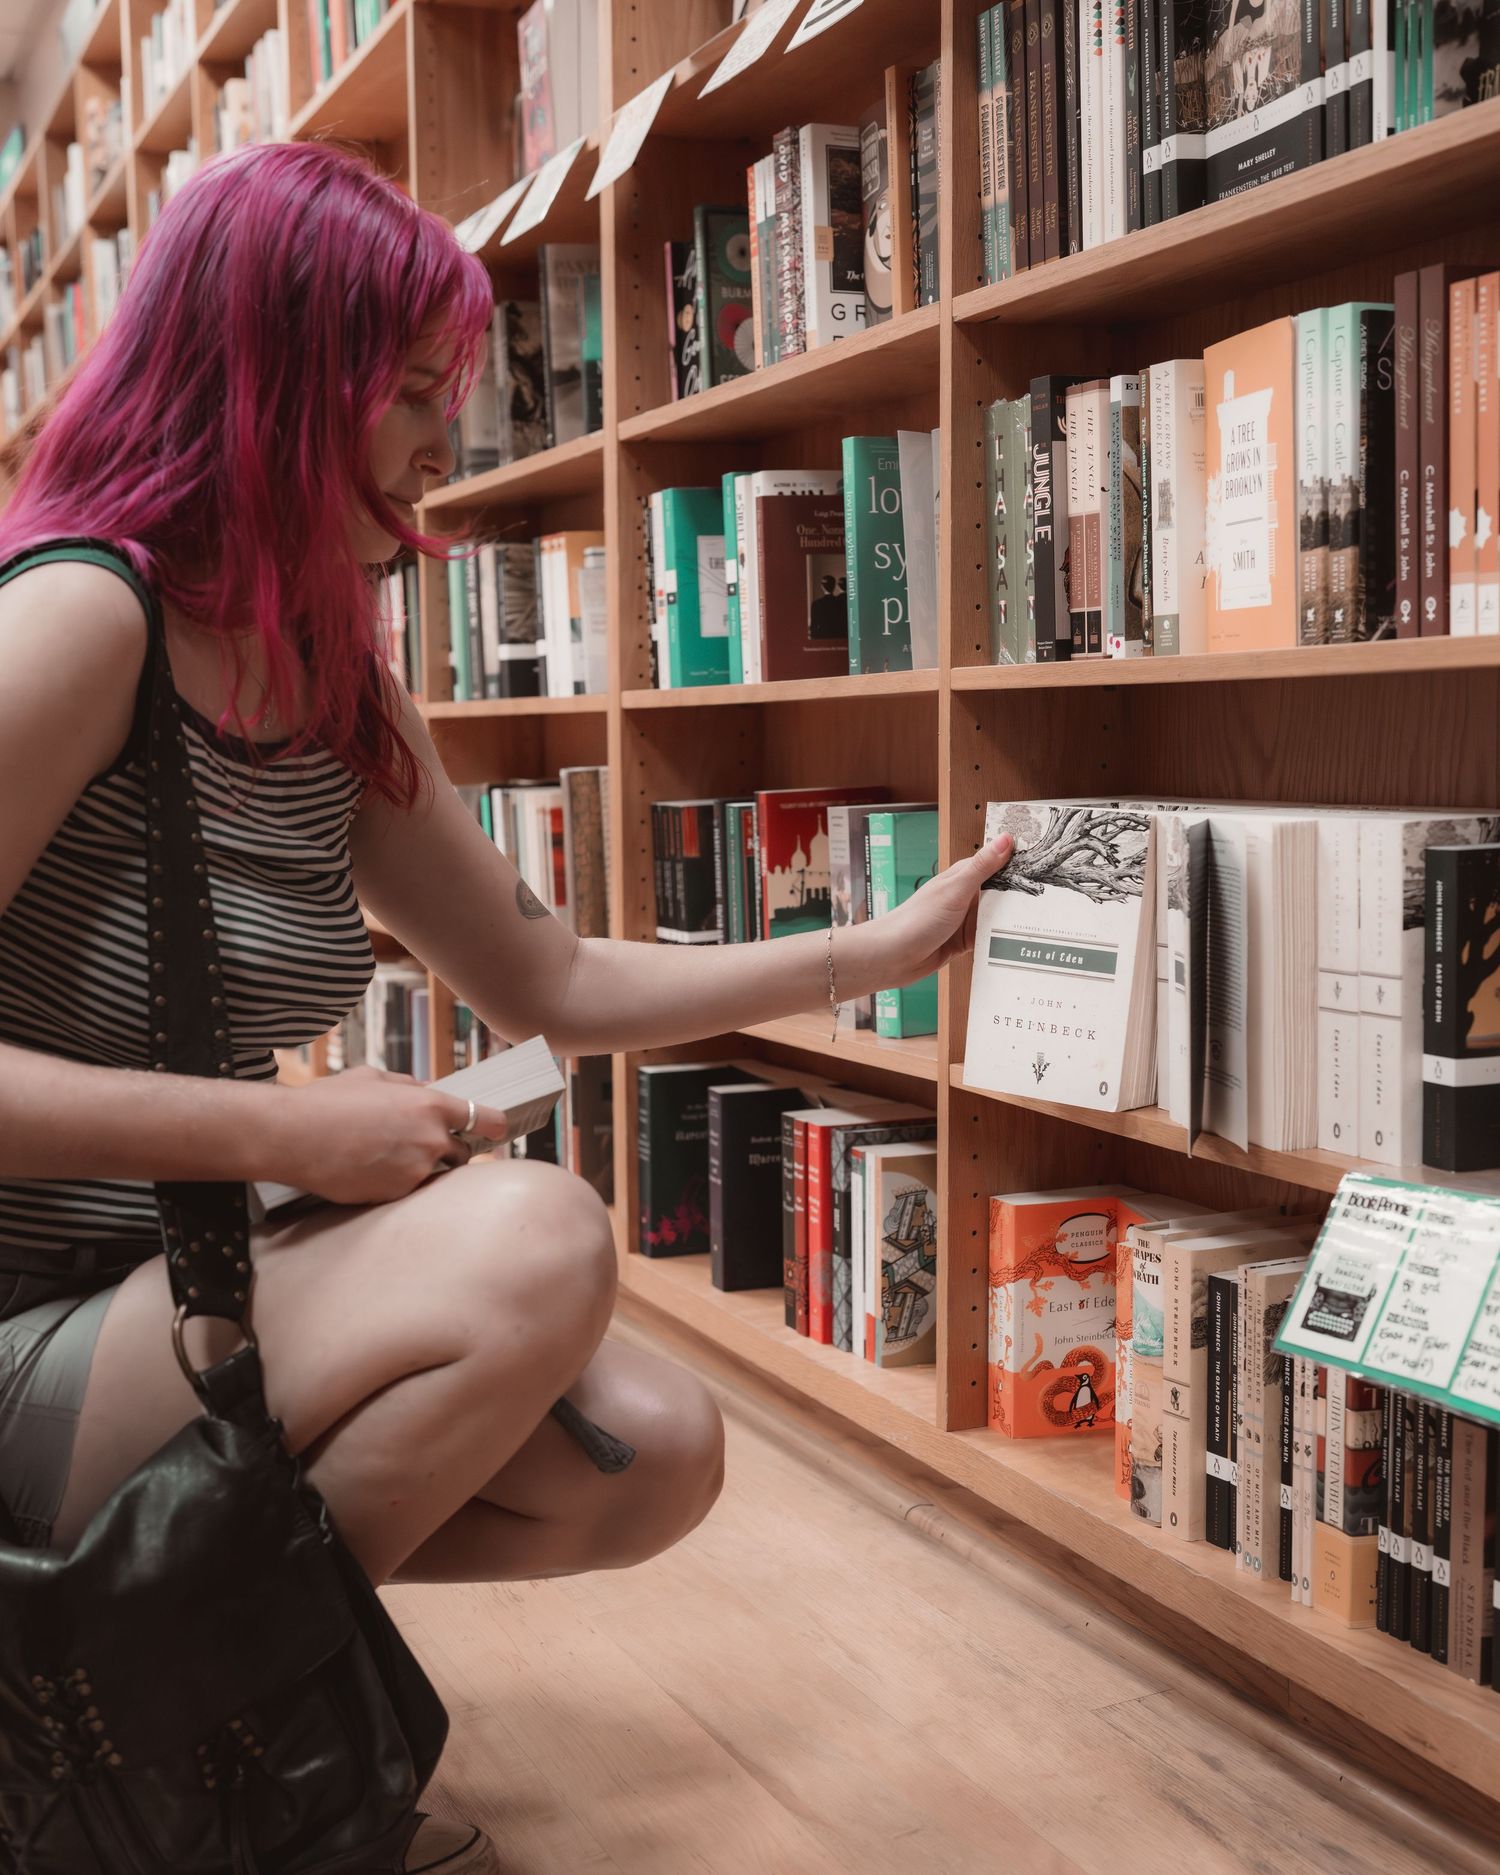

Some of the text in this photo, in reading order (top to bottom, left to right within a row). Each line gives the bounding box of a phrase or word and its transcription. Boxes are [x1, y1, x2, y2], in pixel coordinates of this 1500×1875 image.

[1044, 63, 1054, 176] FRANKENSTEIN
[981, 104, 991, 197] FRANKENSTEIN
[995, 96, 1005, 190] FRANKENSTEIN
[778, 144, 788, 183] OVID
[1237, 148, 1277, 171] MARY SHELLEY
[1218, 161, 1295, 200] FRANKENSTEIN: THE 1818 TEXT
[1302, 337, 1316, 399] Capture
[1331, 334, 1345, 397] Capture
[1396, 326, 1416, 430] Hungerheart
[1421, 317, 1441, 424] Hungerheart
[1155, 376, 1164, 468] IN BROOKLYN
[1305, 402, 1315, 419] the
[1335, 400, 1344, 418] the
[1230, 420, 1256, 446] A TREE
[1335, 422, 1347, 471] Castle
[1069, 411, 1078, 504] THE JUNGLE
[1226, 446, 1261, 474] GROWS IN
[1306, 424, 1318, 471] Castle
[877, 456, 899, 471] Emi
[1087, 444, 1095, 501] JUNGLE
[867, 475, 900, 515] lo
[1033, 443, 1052, 543] JUNGLE
[1143, 489, 1147, 500] of
[1225, 472, 1263, 500] BROOKLYN
[1400, 469, 1410, 581] C. Marshall St. John
[1425, 464, 1435, 578] C. Marshall St. John
[845, 490, 857, 600] loving sylvia plath
[873, 541, 907, 582] sy
[1232, 549, 1256, 572] SMITH
[1435, 880, 1443, 906] JOHN
[1435, 907, 1443, 953] STEINBECK
[1020, 946, 1084, 966] East of Eden
[1435, 963, 1443, 984] EAST
[1030, 997, 1064, 1009] JOHN
[1435, 985, 1442, 998] OF
[993, 1014, 1097, 1041] STEINBECK
[1070, 1229, 1104, 1238] PENGUIN
[1070, 1240, 1104, 1248] CLASSICS
[1137, 1238, 1150, 1248] THE
[1140, 1261, 1147, 1273] of
[1049, 1300, 1073, 1313] East
[1094, 1295, 1115, 1308] Ede
[1054, 1329, 1116, 1346] John Steinbeck
[1232, 1374, 1237, 1382] IN
[1215, 1405, 1220, 1414] OF
[1284, 1395, 1290, 1408] OF
[1331, 1391, 1341, 1433] JOHN
[1246, 1463, 1251, 1477] OF
[1255, 1468, 1260, 1482] OF
[1462, 1433, 1473, 1565] The Red and the Black
[1443, 1508, 1449, 1521] OF
[1465, 1583, 1475, 1667] STENDHAL
